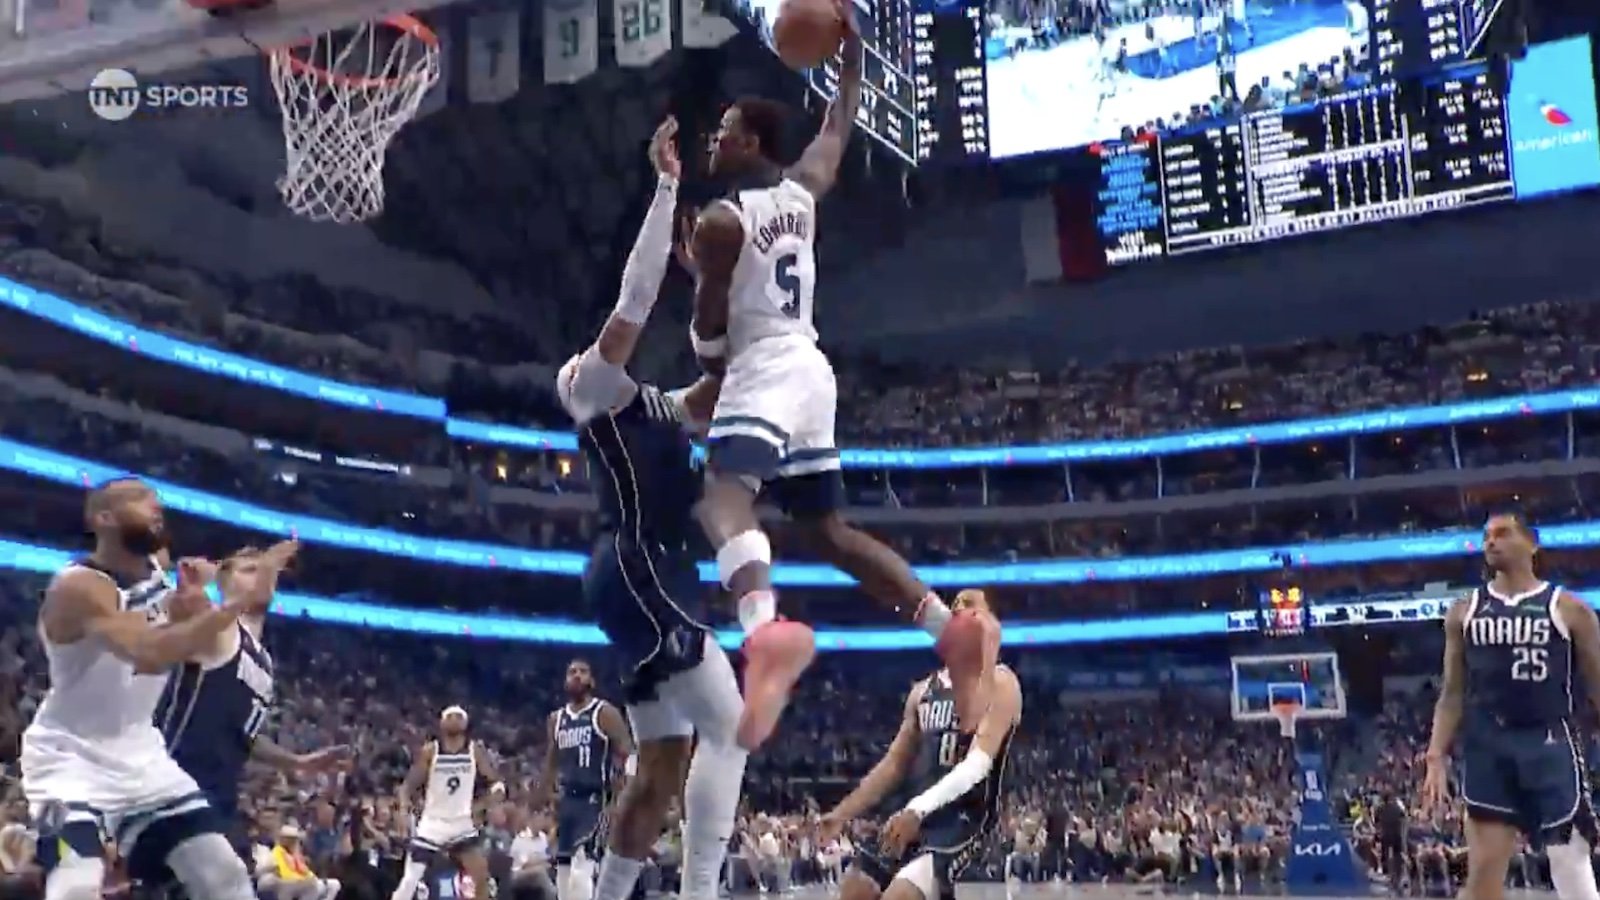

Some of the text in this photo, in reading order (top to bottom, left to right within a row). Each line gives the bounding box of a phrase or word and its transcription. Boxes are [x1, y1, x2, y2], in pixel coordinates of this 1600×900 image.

[775, 253, 801, 319] 5
[1471, 616, 1550, 646] MAVS
[1511, 647, 1549, 682] 25
[558, 725, 592, 749] MAVS
[578, 744, 591, 768] 11
[446, 776, 461, 796] 9
[1294, 842, 1341, 856] KIA
